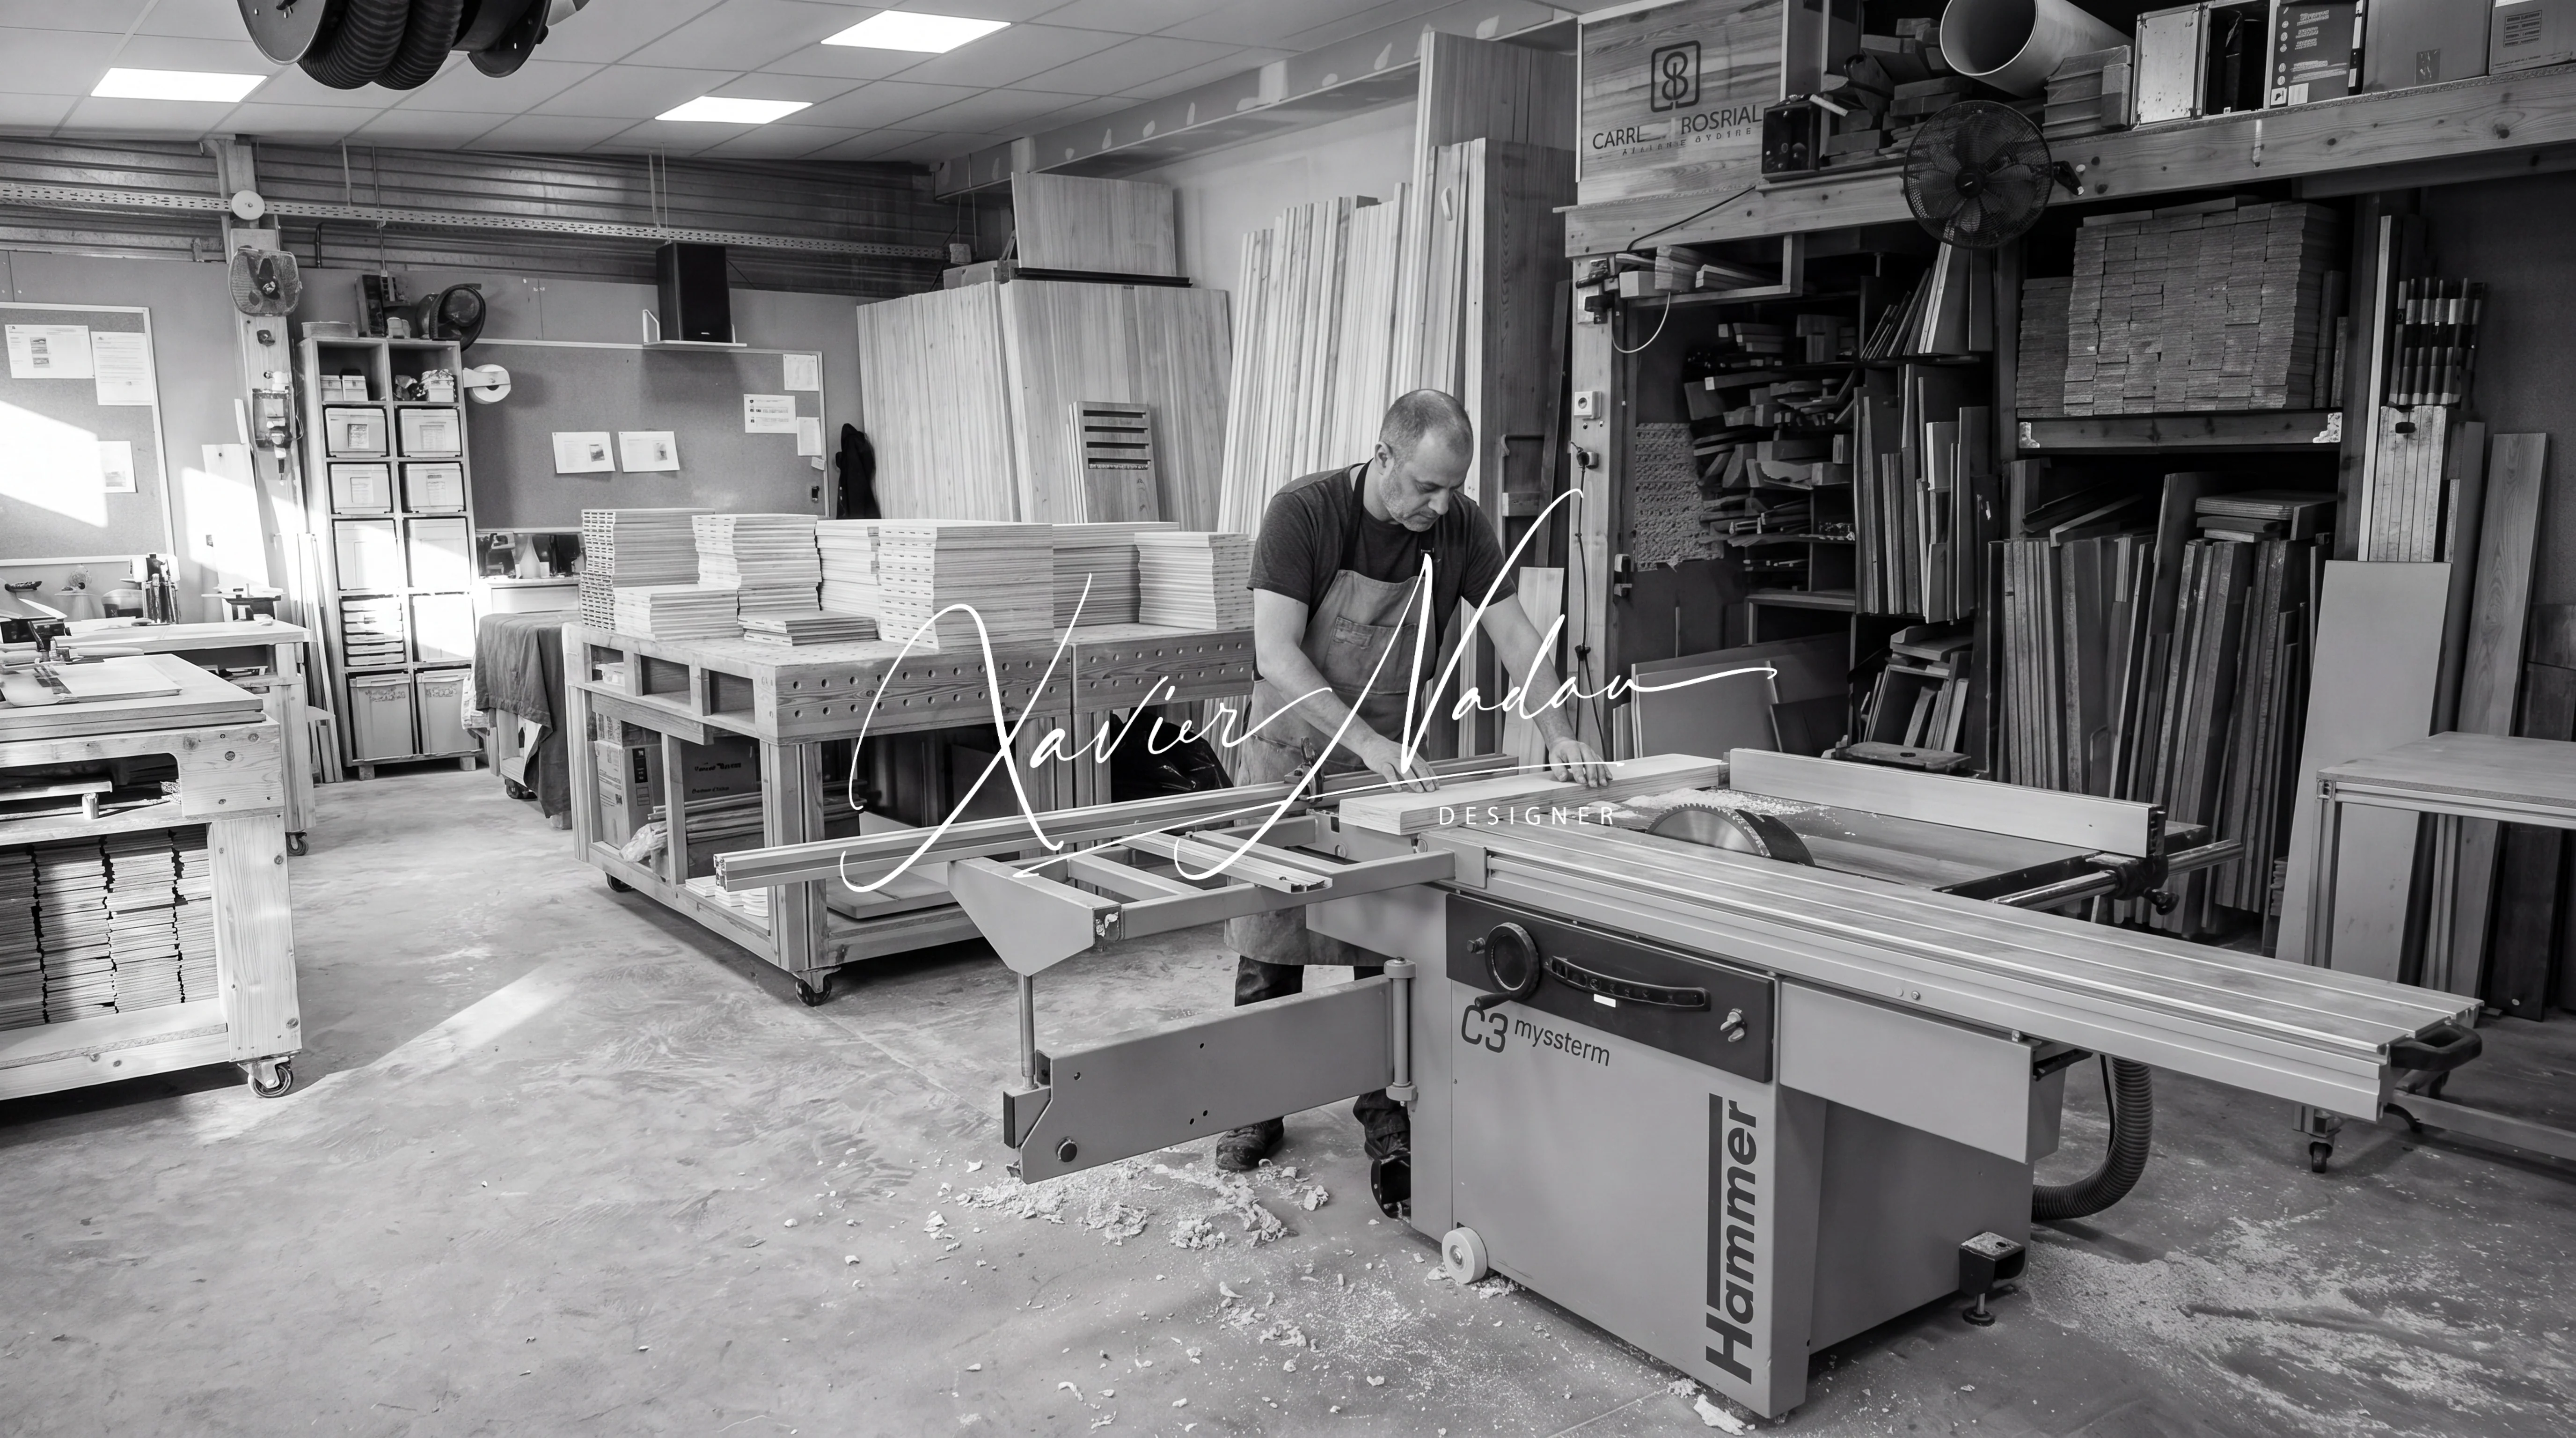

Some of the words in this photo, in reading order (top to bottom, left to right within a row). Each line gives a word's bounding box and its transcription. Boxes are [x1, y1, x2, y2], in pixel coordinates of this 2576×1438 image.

[1461, 1005, 1508, 1053] C3
[1515, 1019, 1610, 1066] myssterm
[1706, 1100, 1756, 1385] Hammer
